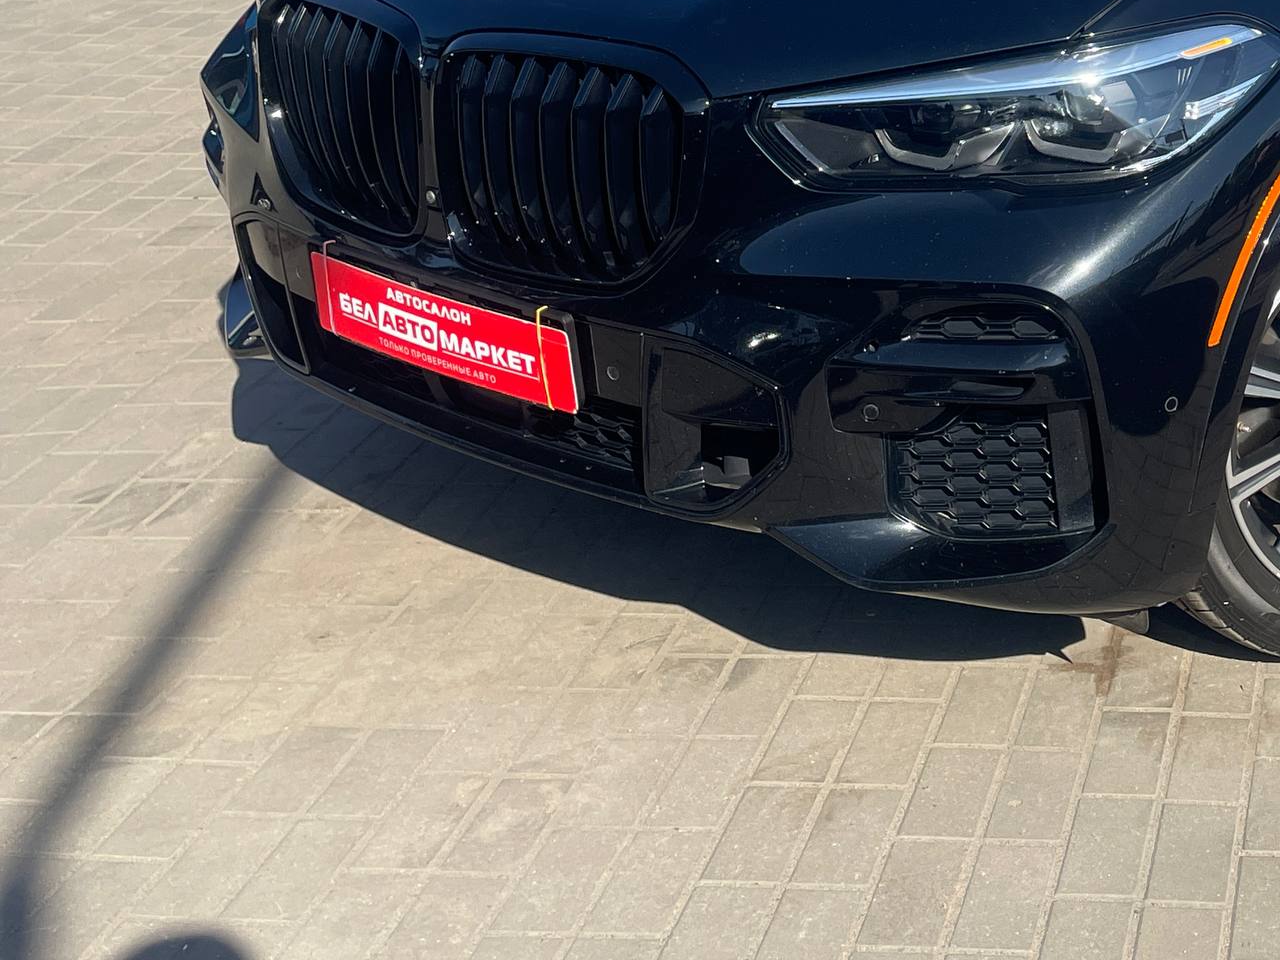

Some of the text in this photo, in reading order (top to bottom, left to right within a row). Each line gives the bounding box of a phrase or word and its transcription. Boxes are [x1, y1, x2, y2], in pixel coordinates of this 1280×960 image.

[386, 287, 471, 326] АВТОСАЛОН
[339, 292, 536, 374] БЕЛ АВТО МАРКЕТ
[379, 336, 497, 384] ТОЛЬКО ПРОВЕРЕННЫЕ АВТО
